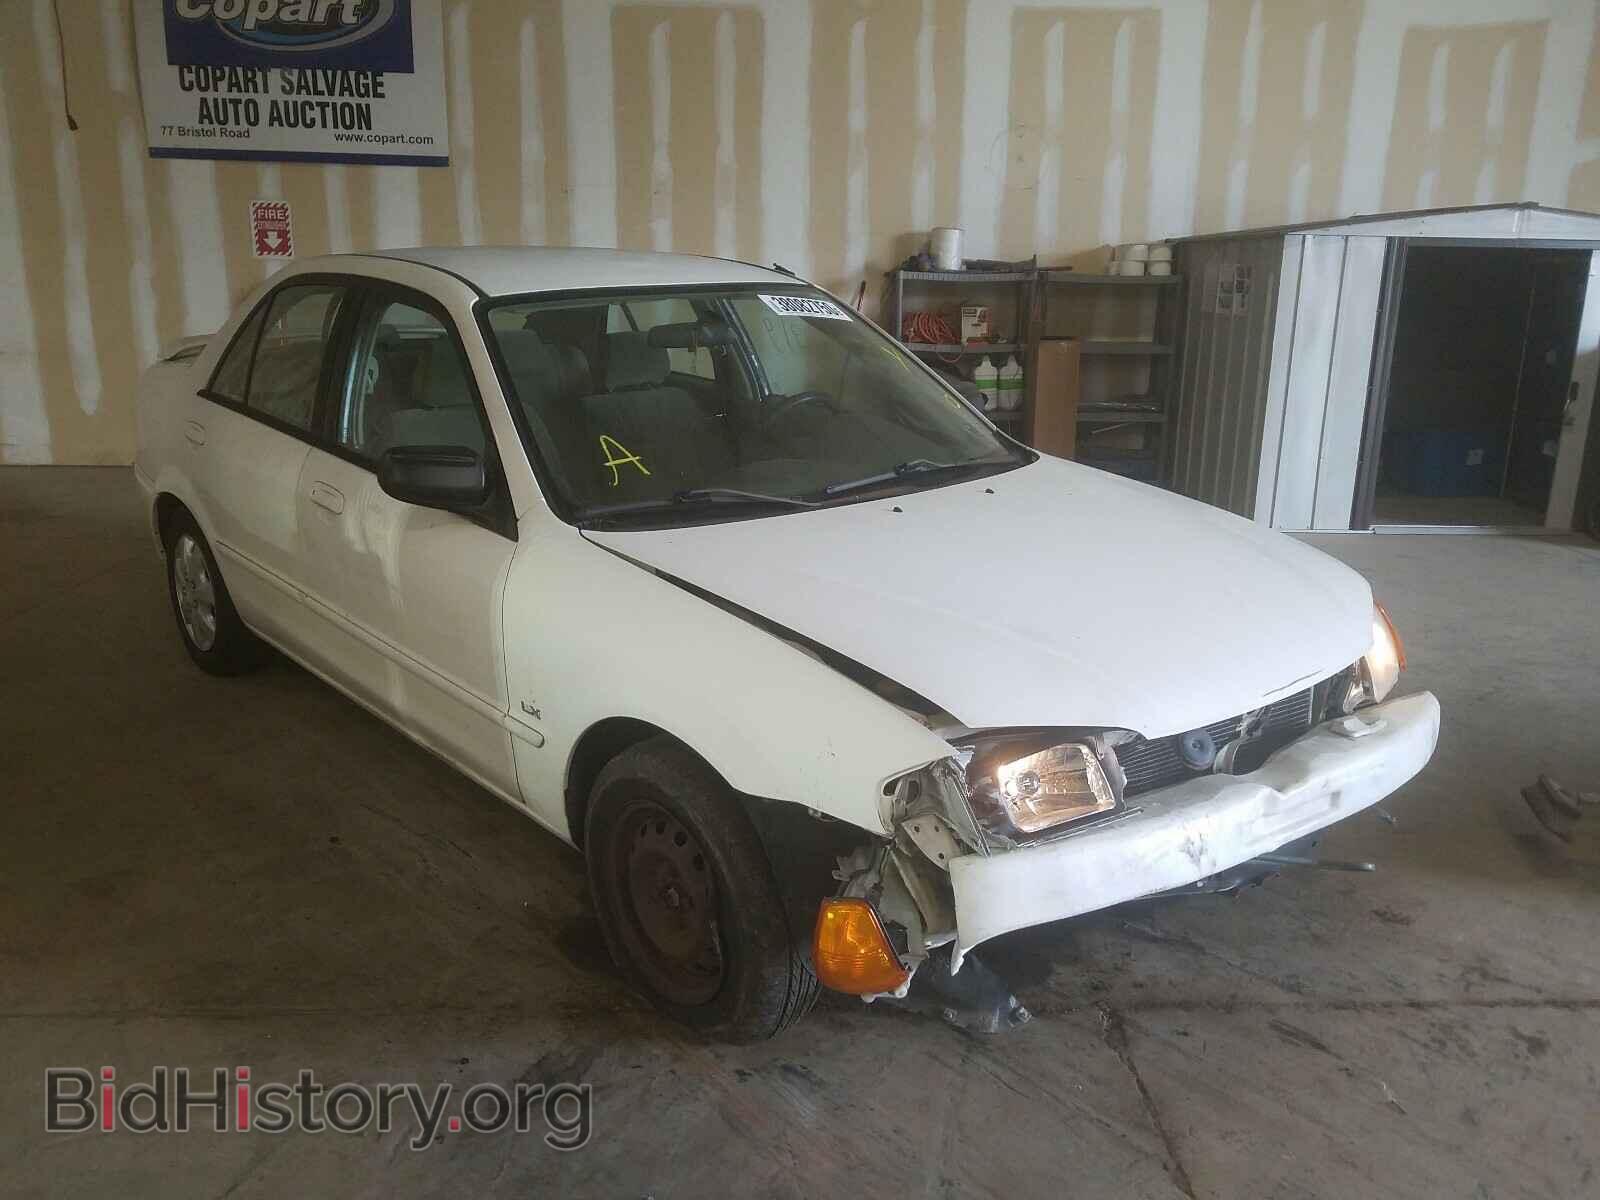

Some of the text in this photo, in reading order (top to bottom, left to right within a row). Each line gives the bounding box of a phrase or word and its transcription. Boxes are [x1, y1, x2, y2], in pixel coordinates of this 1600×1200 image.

[178, 64, 386, 99] COPART SALVAGE
[198, 97, 373, 131] AUTO AUCTION
[160, 125, 251, 139] 77 Bristol Road
[334, 132, 434, 146] www.copart.com
[257, 208, 287, 221] FIRE
[599, 434, 652, 487] A
